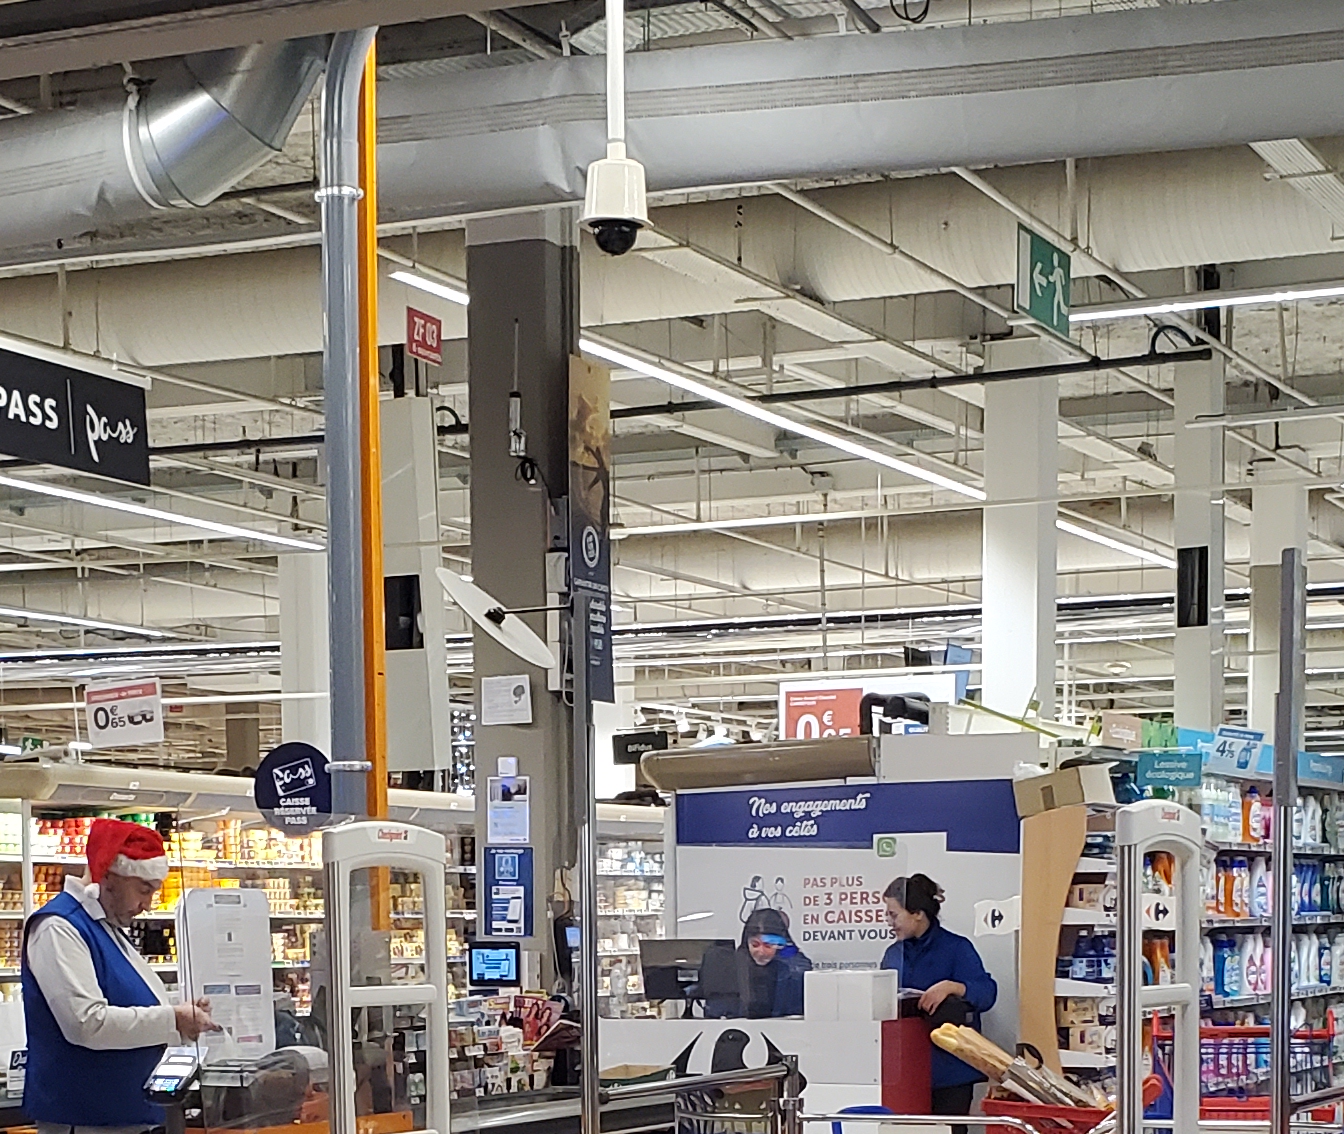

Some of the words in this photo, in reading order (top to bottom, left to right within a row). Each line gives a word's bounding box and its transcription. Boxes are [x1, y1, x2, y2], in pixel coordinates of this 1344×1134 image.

[279, 797, 311, 806] CAISSE
[748, 797, 777, 817] Nos
[780, 793, 871, 818] engagements
[285, 816, 308, 825] PASS
[748, 823, 760, 838] à
[761, 826, 782, 838] vos
[785, 820, 818, 837] côtés
[803, 877, 827, 888] PAS
[830, 876, 864, 887] PLUS
[803, 895, 820, 907] DE
[823, 892, 834, 906] 3
[803, 914, 820, 925] EN
[802, 929, 856, 941] DEVANT
[857, 928, 897, 940] VOUS
